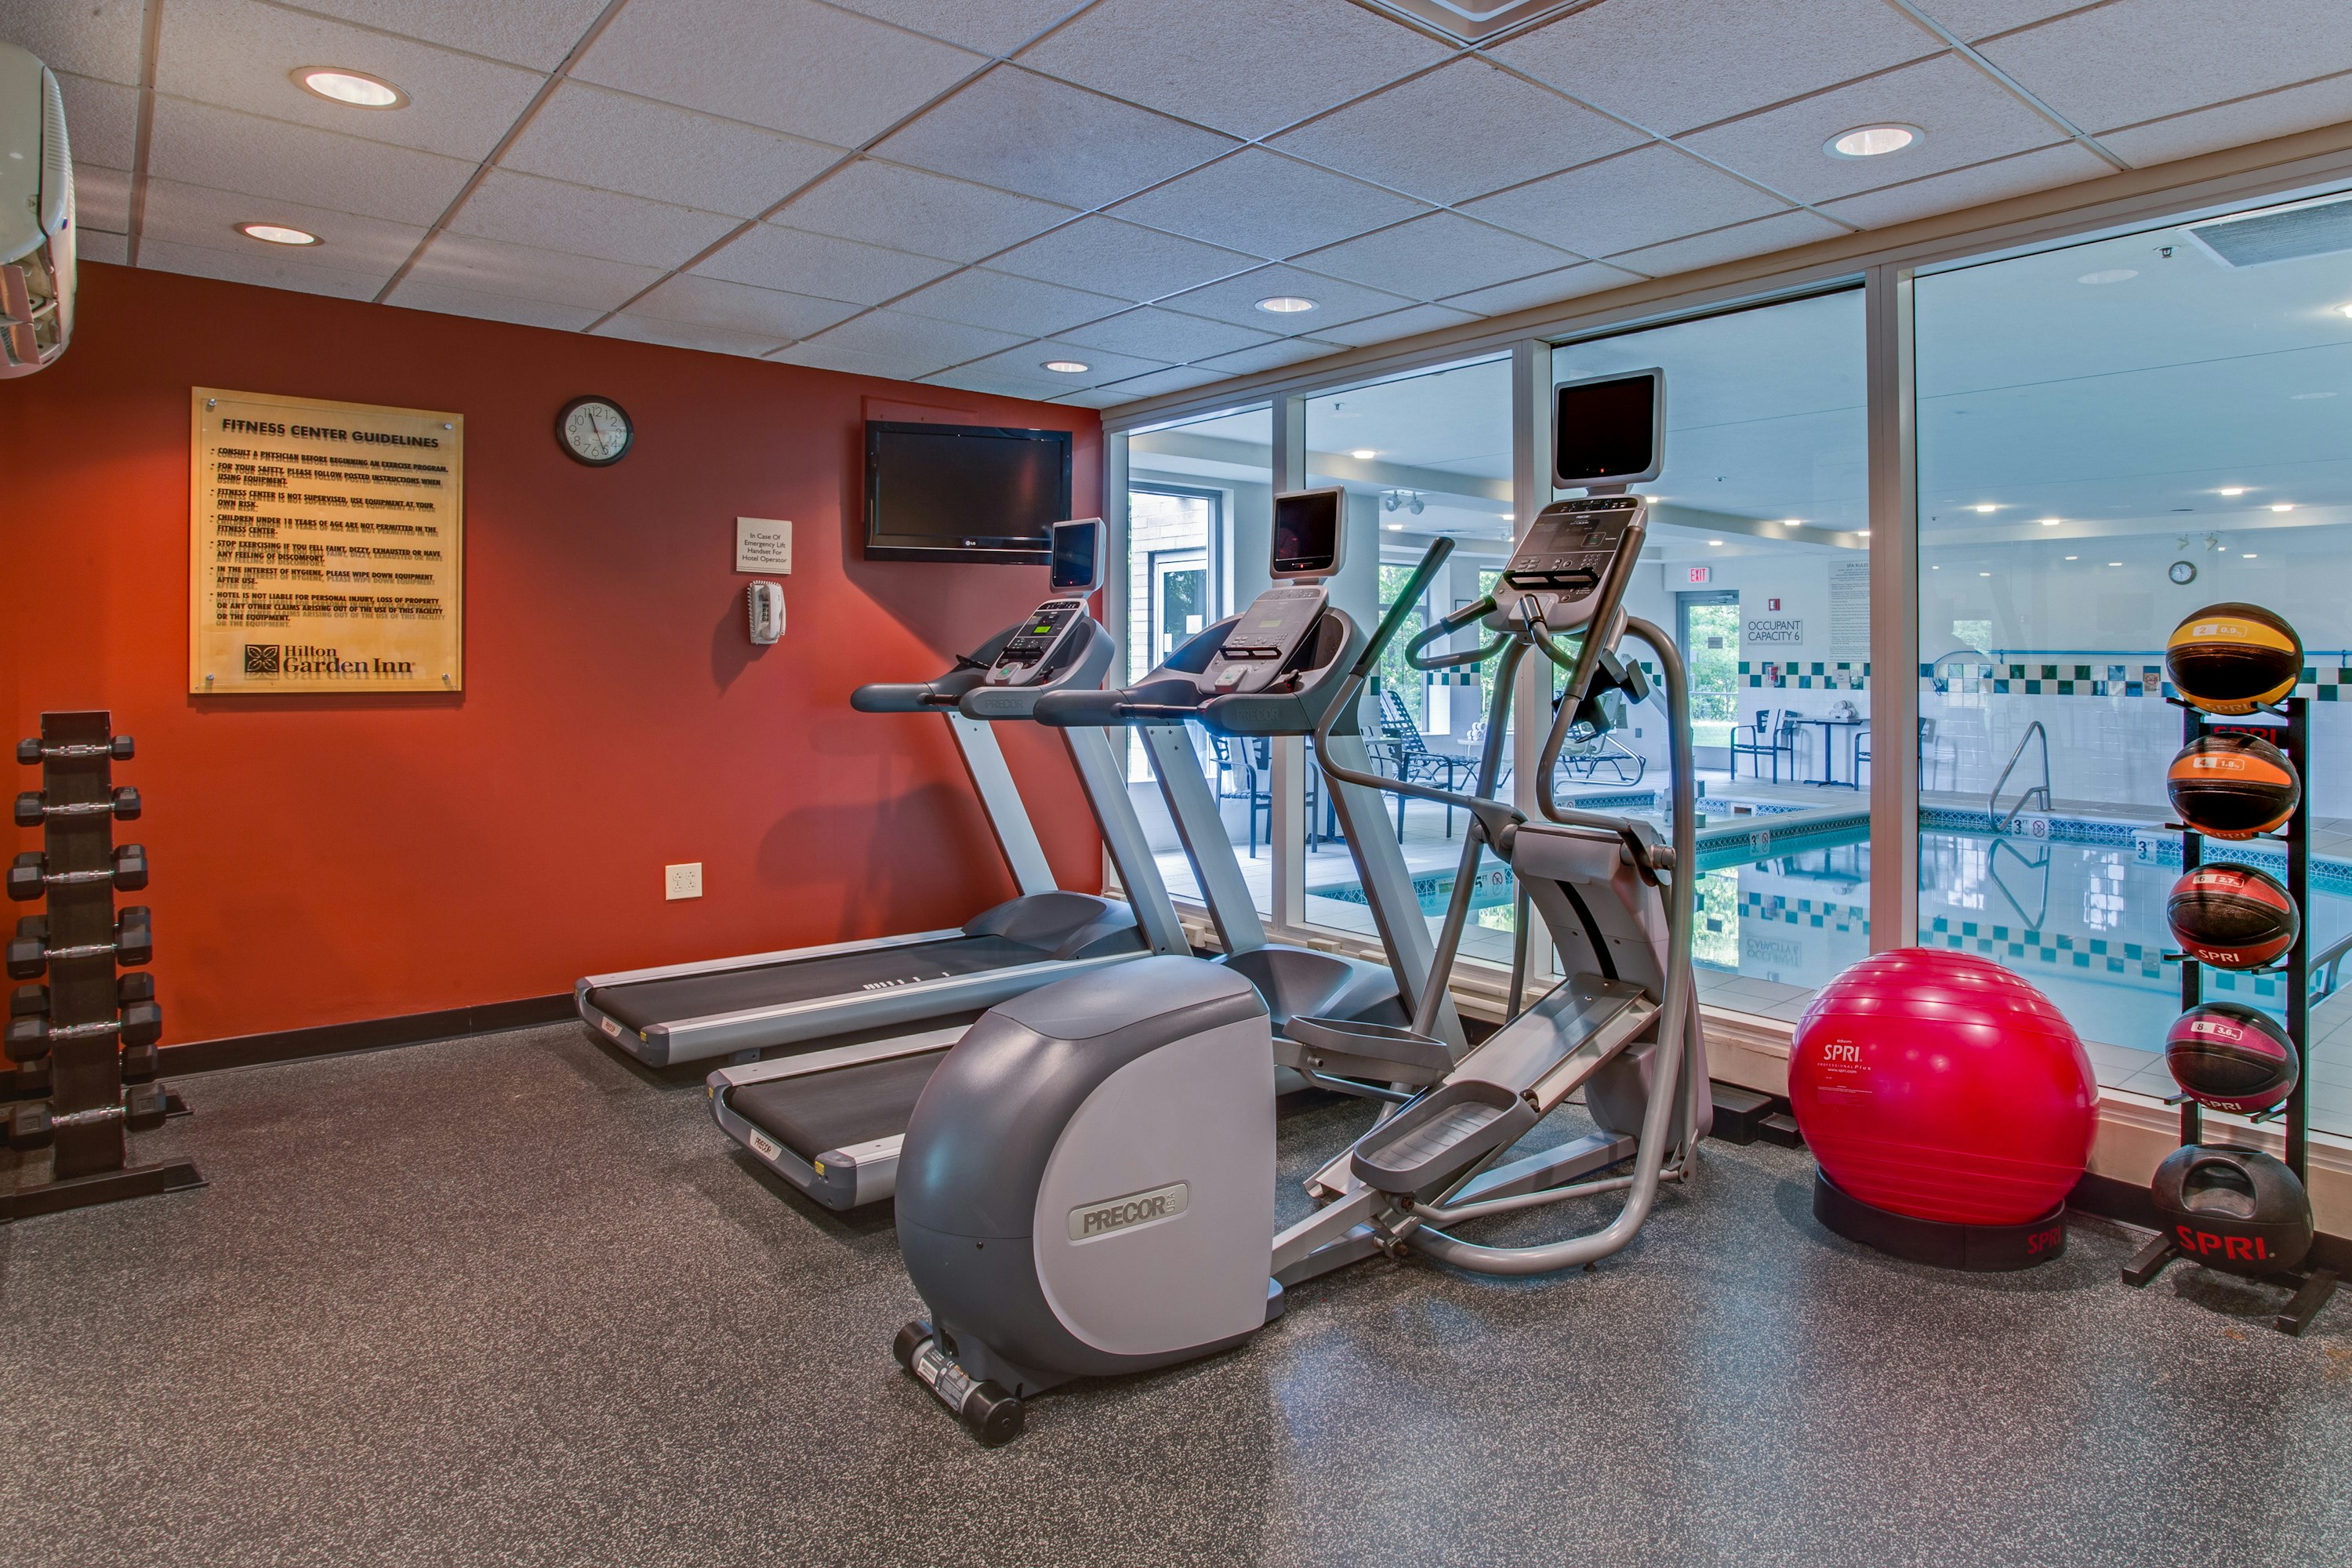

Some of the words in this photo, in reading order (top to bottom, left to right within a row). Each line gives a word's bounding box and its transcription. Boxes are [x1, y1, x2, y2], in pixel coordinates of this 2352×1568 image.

[592, 406, 602, 417] 12
[605, 409, 608, 419] 1
[574, 415, 584, 426] 10
[610, 416, 618, 427] 2
[223, 419, 285, 434] FITNESS
[291, 425, 347, 439] CENTER
[352, 431, 439, 448] GUIDELINES
[568, 425, 577, 434] 9
[615, 428, 622, 438] 3
[574, 435, 580, 446] 8
[611, 439, 617, 448] 4
[583, 444, 590, 453] 7
[592, 447, 599, 457] 6
[601, 445, 609, 455] 5
[260, 451, 299, 460] PHYSICIAN
[329, 457, 368, 466] BEGINNING
[382, 461, 412, 470] EXERCISE
[413, 464, 448, 473] PROGRAM.
[244, 475, 289, 485] EQUIPMENT.
[372, 474, 419, 484] INSTRUCTIONS
[304, 494, 348, 504] SUPERVISED,
[365, 499, 404, 507] EQUIPMENT
[239, 541, 281, 550] EXERCISING
[744, 540, 775, 549] Emergency
[278, 554, 325, 562] DISCOMFORT.
[1690, 568, 1706, 582] EXIT
[1748, 621, 1801, 630] OCCUPANT
[1748, 632, 1792, 641] CAPACITY
[1795, 631, 1800, 641] 6
[284, 645, 337, 657] Hilton
[283, 657, 368, 673] Garden
[373, 658, 413, 673] Inn
[2014, 819, 2021, 830] 3
[2138, 840, 2147, 853] 3
[2198, 949, 2240, 963] SPRI
[1824, 1044, 1860, 1062] SPRI
[2200, 1098, 2241, 1111] SPRI
[755, 1137, 771, 1155] PRECOR
[1083, 1196, 1166, 1234] PRECOR
[1166, 1191, 1176, 1213] USA
[2027, 1226, 2062, 1254] SPRI
[2176, 1225, 2267, 1261] SPRI
